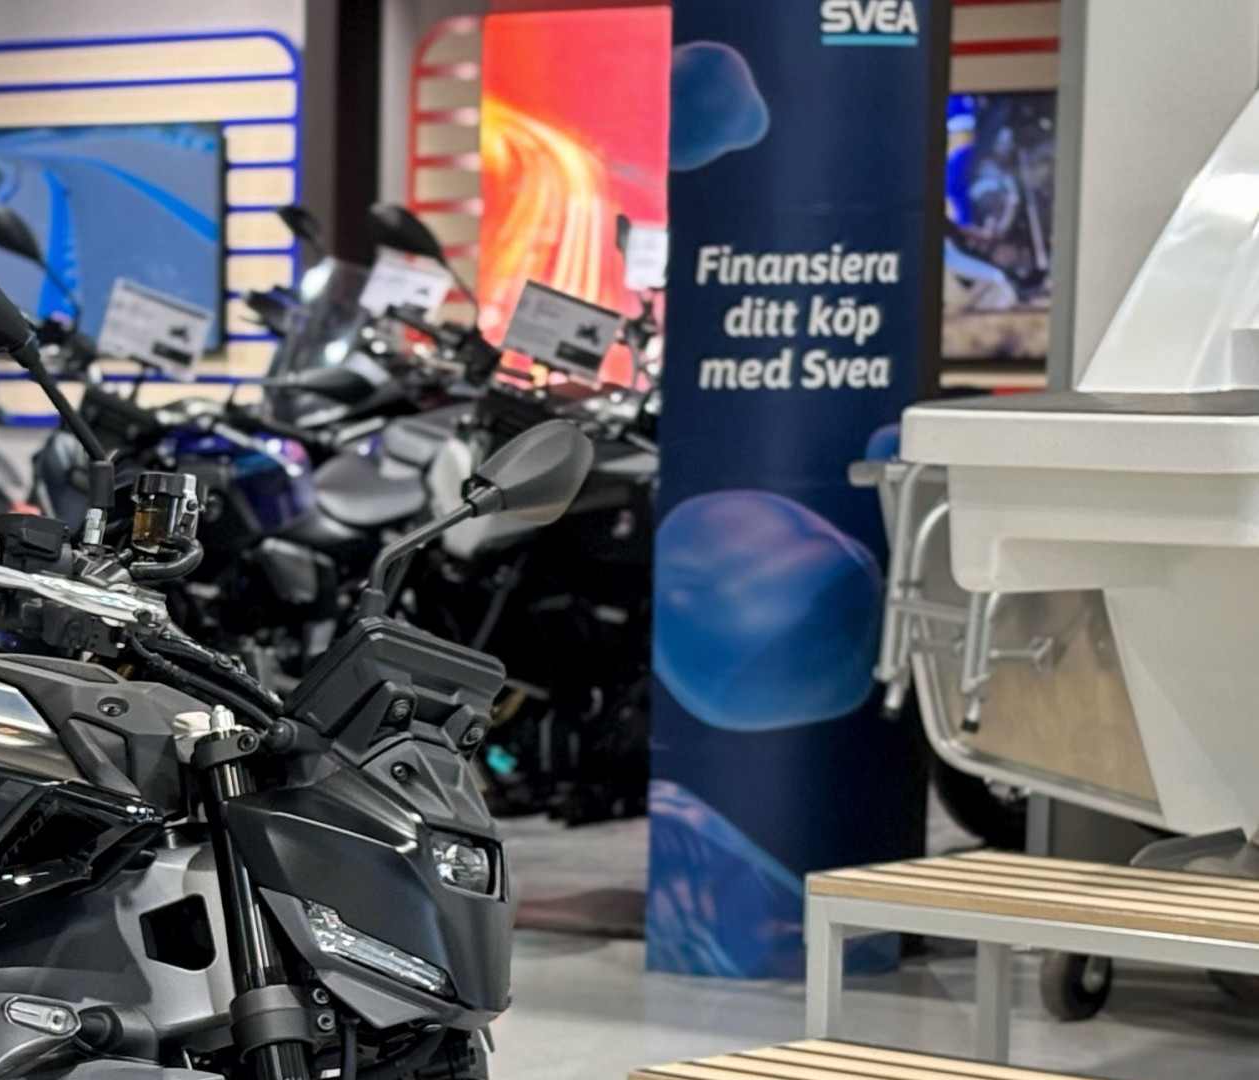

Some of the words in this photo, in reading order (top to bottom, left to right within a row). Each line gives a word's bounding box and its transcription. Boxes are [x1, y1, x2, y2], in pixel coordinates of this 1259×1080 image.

[820, 0, 919, 33] SVEA
[696, 244, 900, 286] Finansiera
[724, 296, 799, 338] ditt
[808, 296, 881, 346] köp
[698, 348, 794, 390] med
[801, 350, 890, 390] Svea
